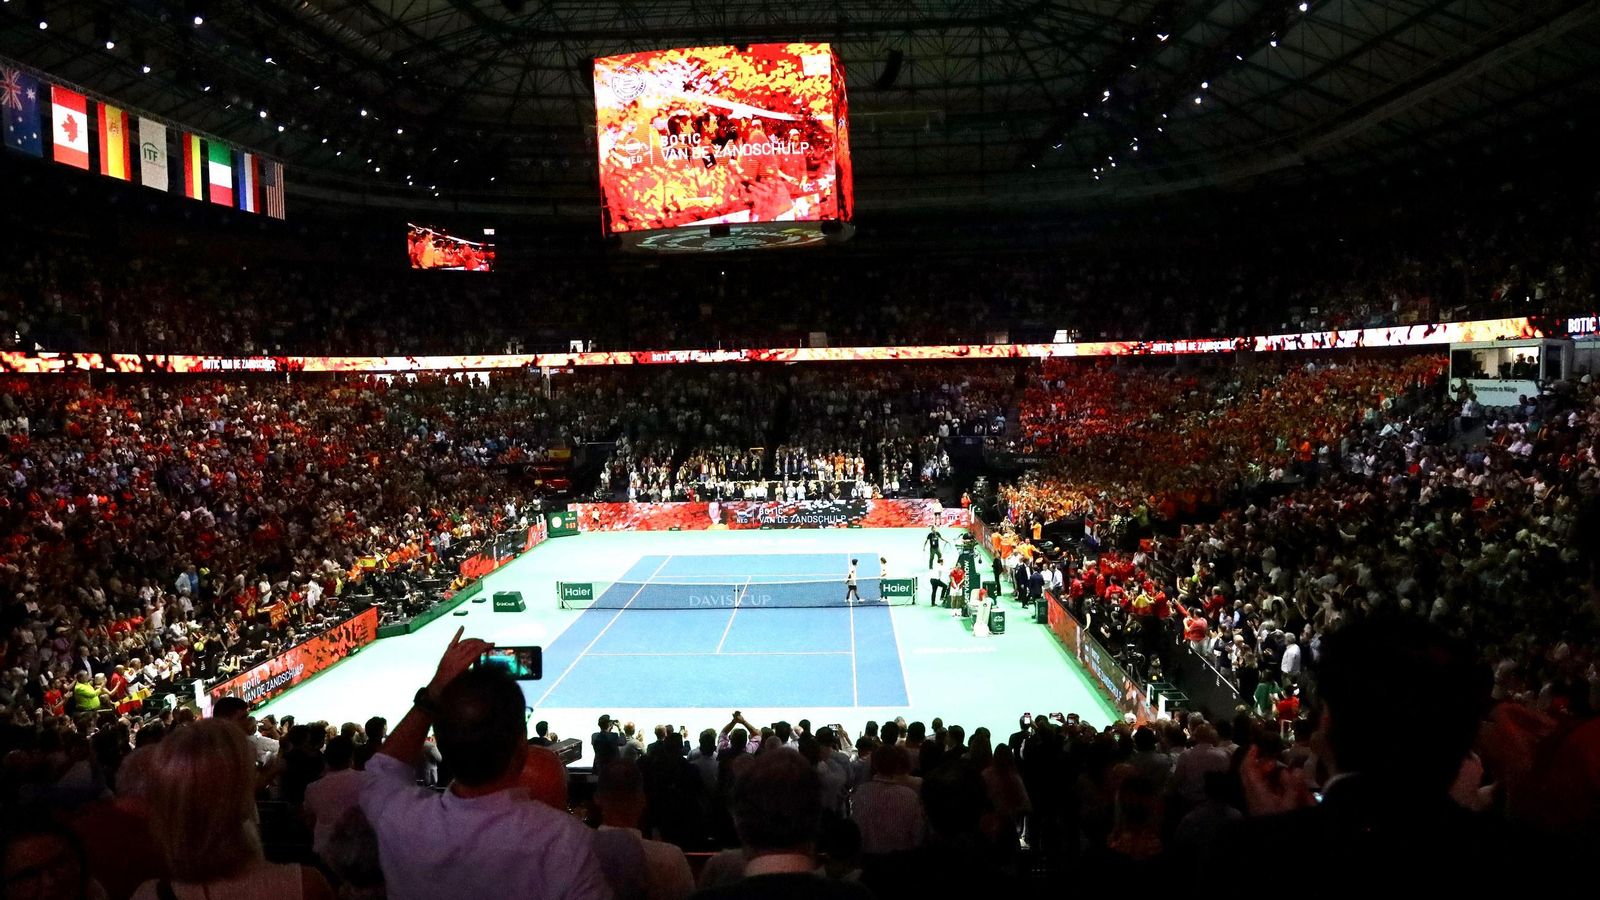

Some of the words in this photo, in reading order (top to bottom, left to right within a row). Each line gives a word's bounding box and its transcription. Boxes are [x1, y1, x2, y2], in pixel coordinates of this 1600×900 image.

[660, 132, 701, 148] BOTIC
[143, 147, 158, 162] ITF
[660, 146, 690, 161] VAN
[692, 145, 710, 159] DE
[714, 141, 810, 158] ZANDSCHULP
[1567, 316, 1597, 333] BOTIC
[760, 507, 784, 515] BOTIC
[760, 516, 775, 524] VAN
[777, 515, 788, 523] DE
[790, 514, 847, 524] ZANDSCHULP
[565, 588, 590, 596] Haier
[883, 584, 910, 593] Haier
[689, 595, 734, 606] DAVIS
[740, 594, 772, 606] CUP
[242, 689, 256, 703] VAN
[256, 683, 266, 697] DE
[266, 663, 304, 692] ZANDSCHULP
[242, 675, 261, 692] BOTIC
